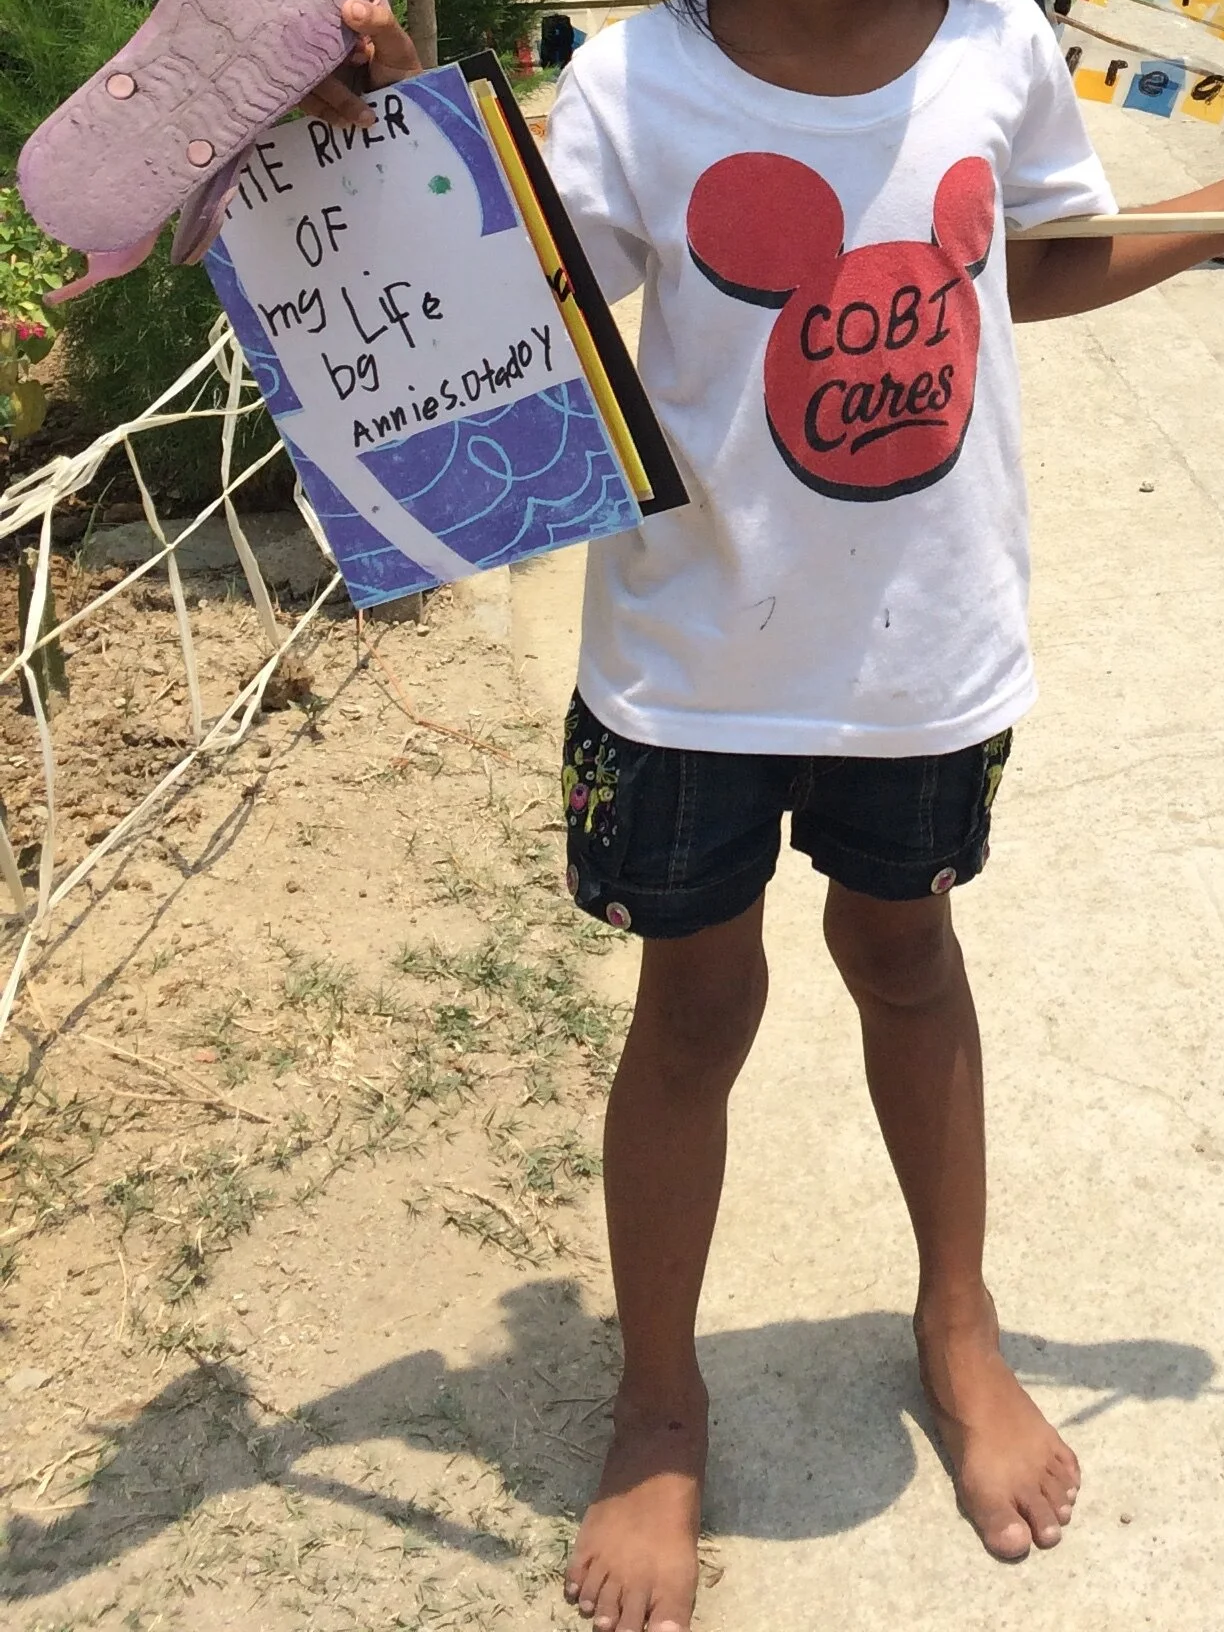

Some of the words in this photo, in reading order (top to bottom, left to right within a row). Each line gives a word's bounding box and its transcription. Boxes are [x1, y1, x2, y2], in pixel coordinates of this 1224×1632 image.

[224, 141, 294, 219] HE
[307, 94, 410, 168] RIVER
[296, 205, 348, 268] OF
[258, 287, 327, 337] my
[800, 278, 962, 361] COBI
[804, 364, 955, 453] Cares
